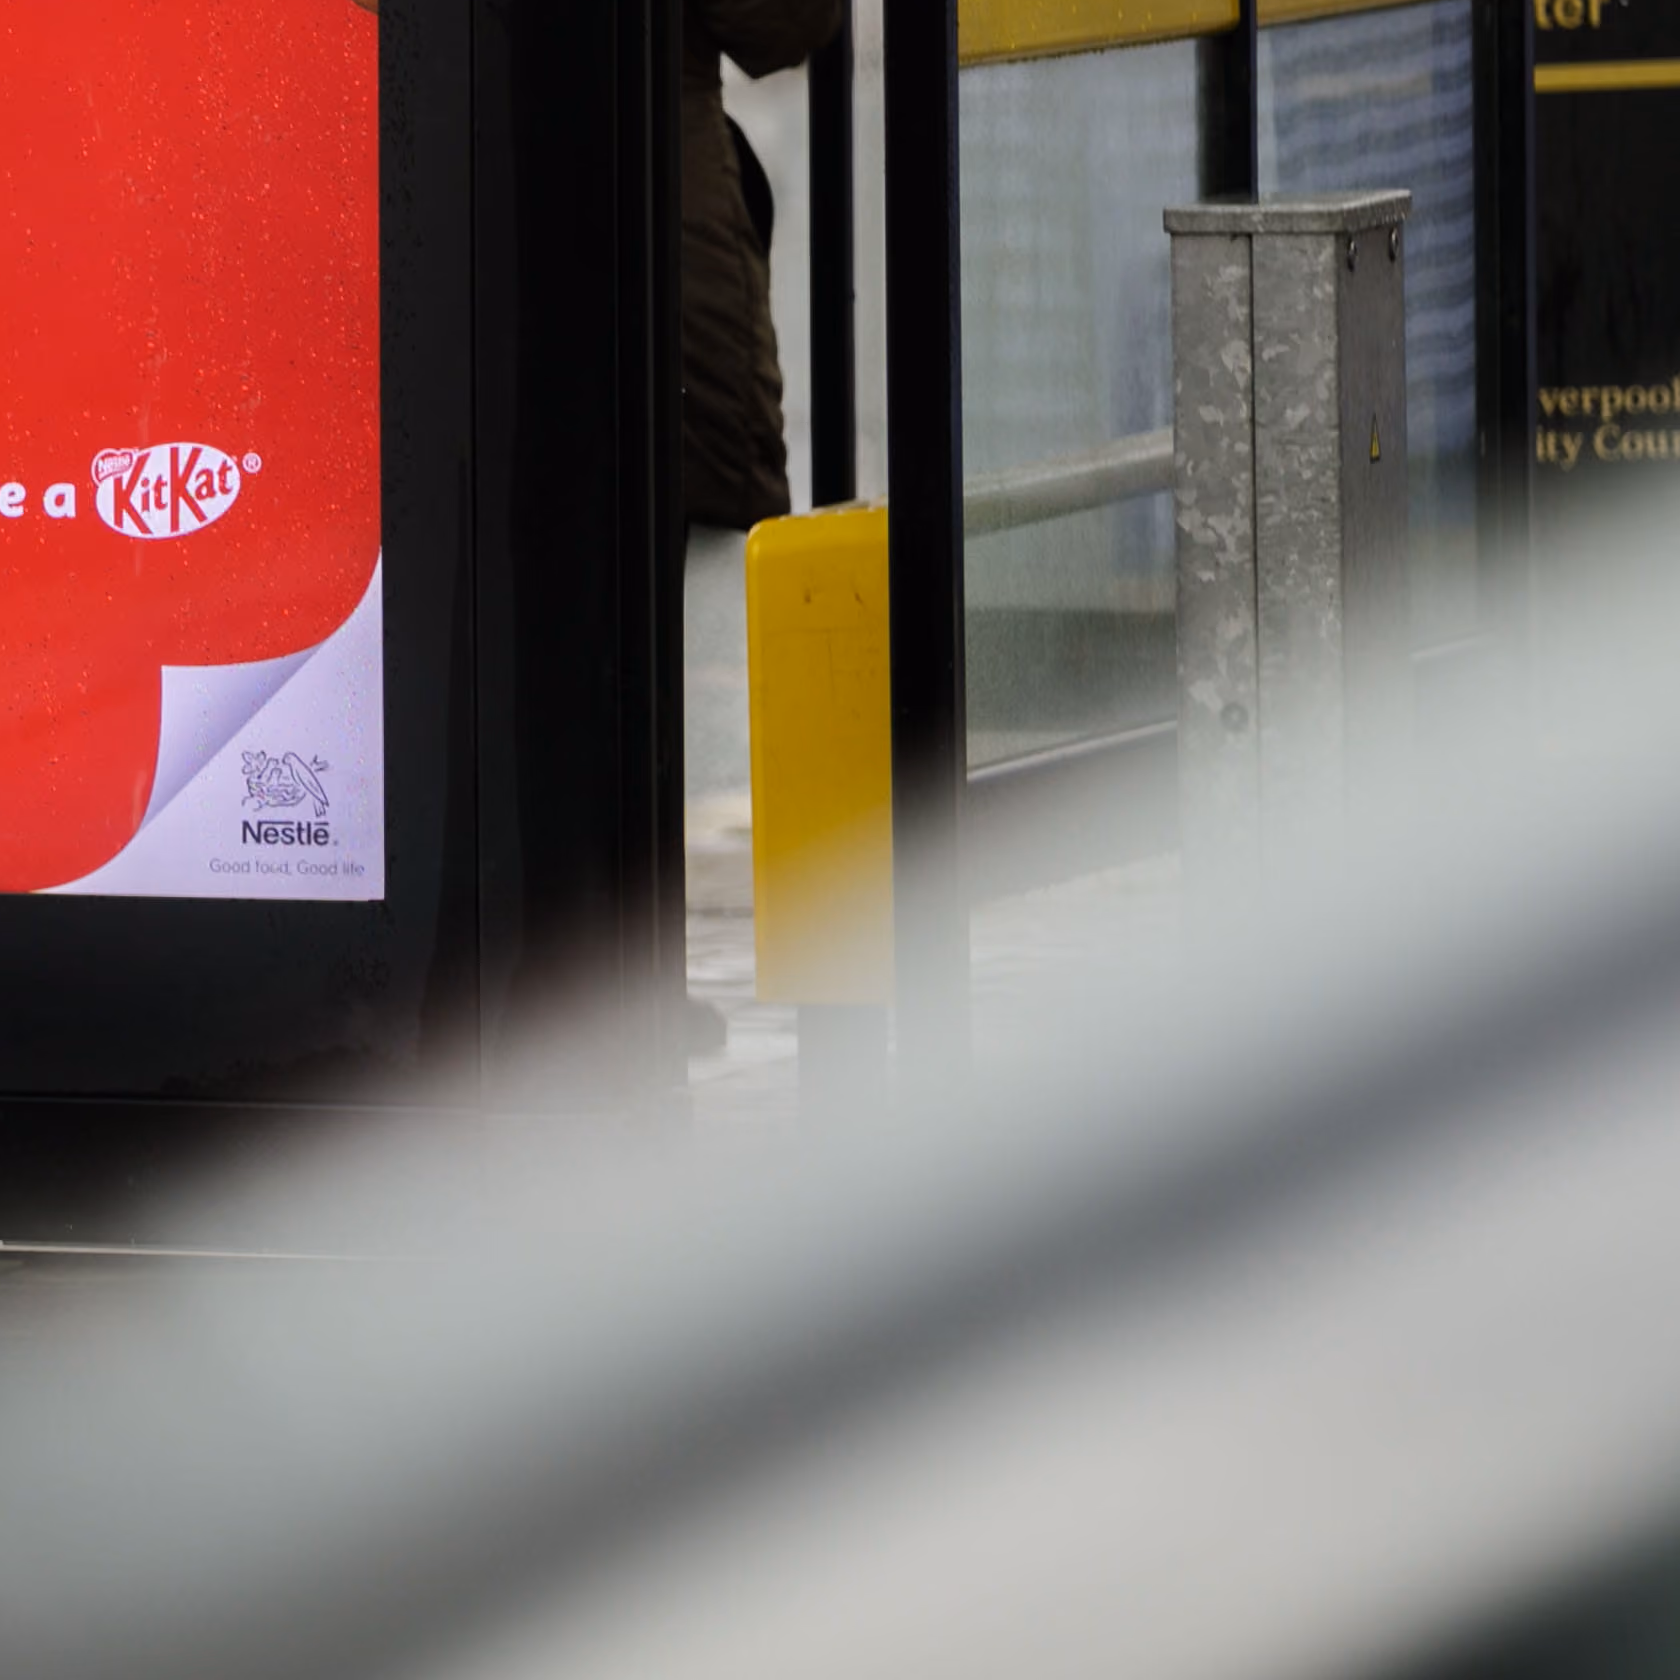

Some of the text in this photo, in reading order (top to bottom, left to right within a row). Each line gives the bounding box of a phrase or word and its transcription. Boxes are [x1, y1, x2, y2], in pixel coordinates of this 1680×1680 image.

[43, 483, 76, 518] a
[208, 858, 250, 874] Good
[296, 859, 338, 876] Good
